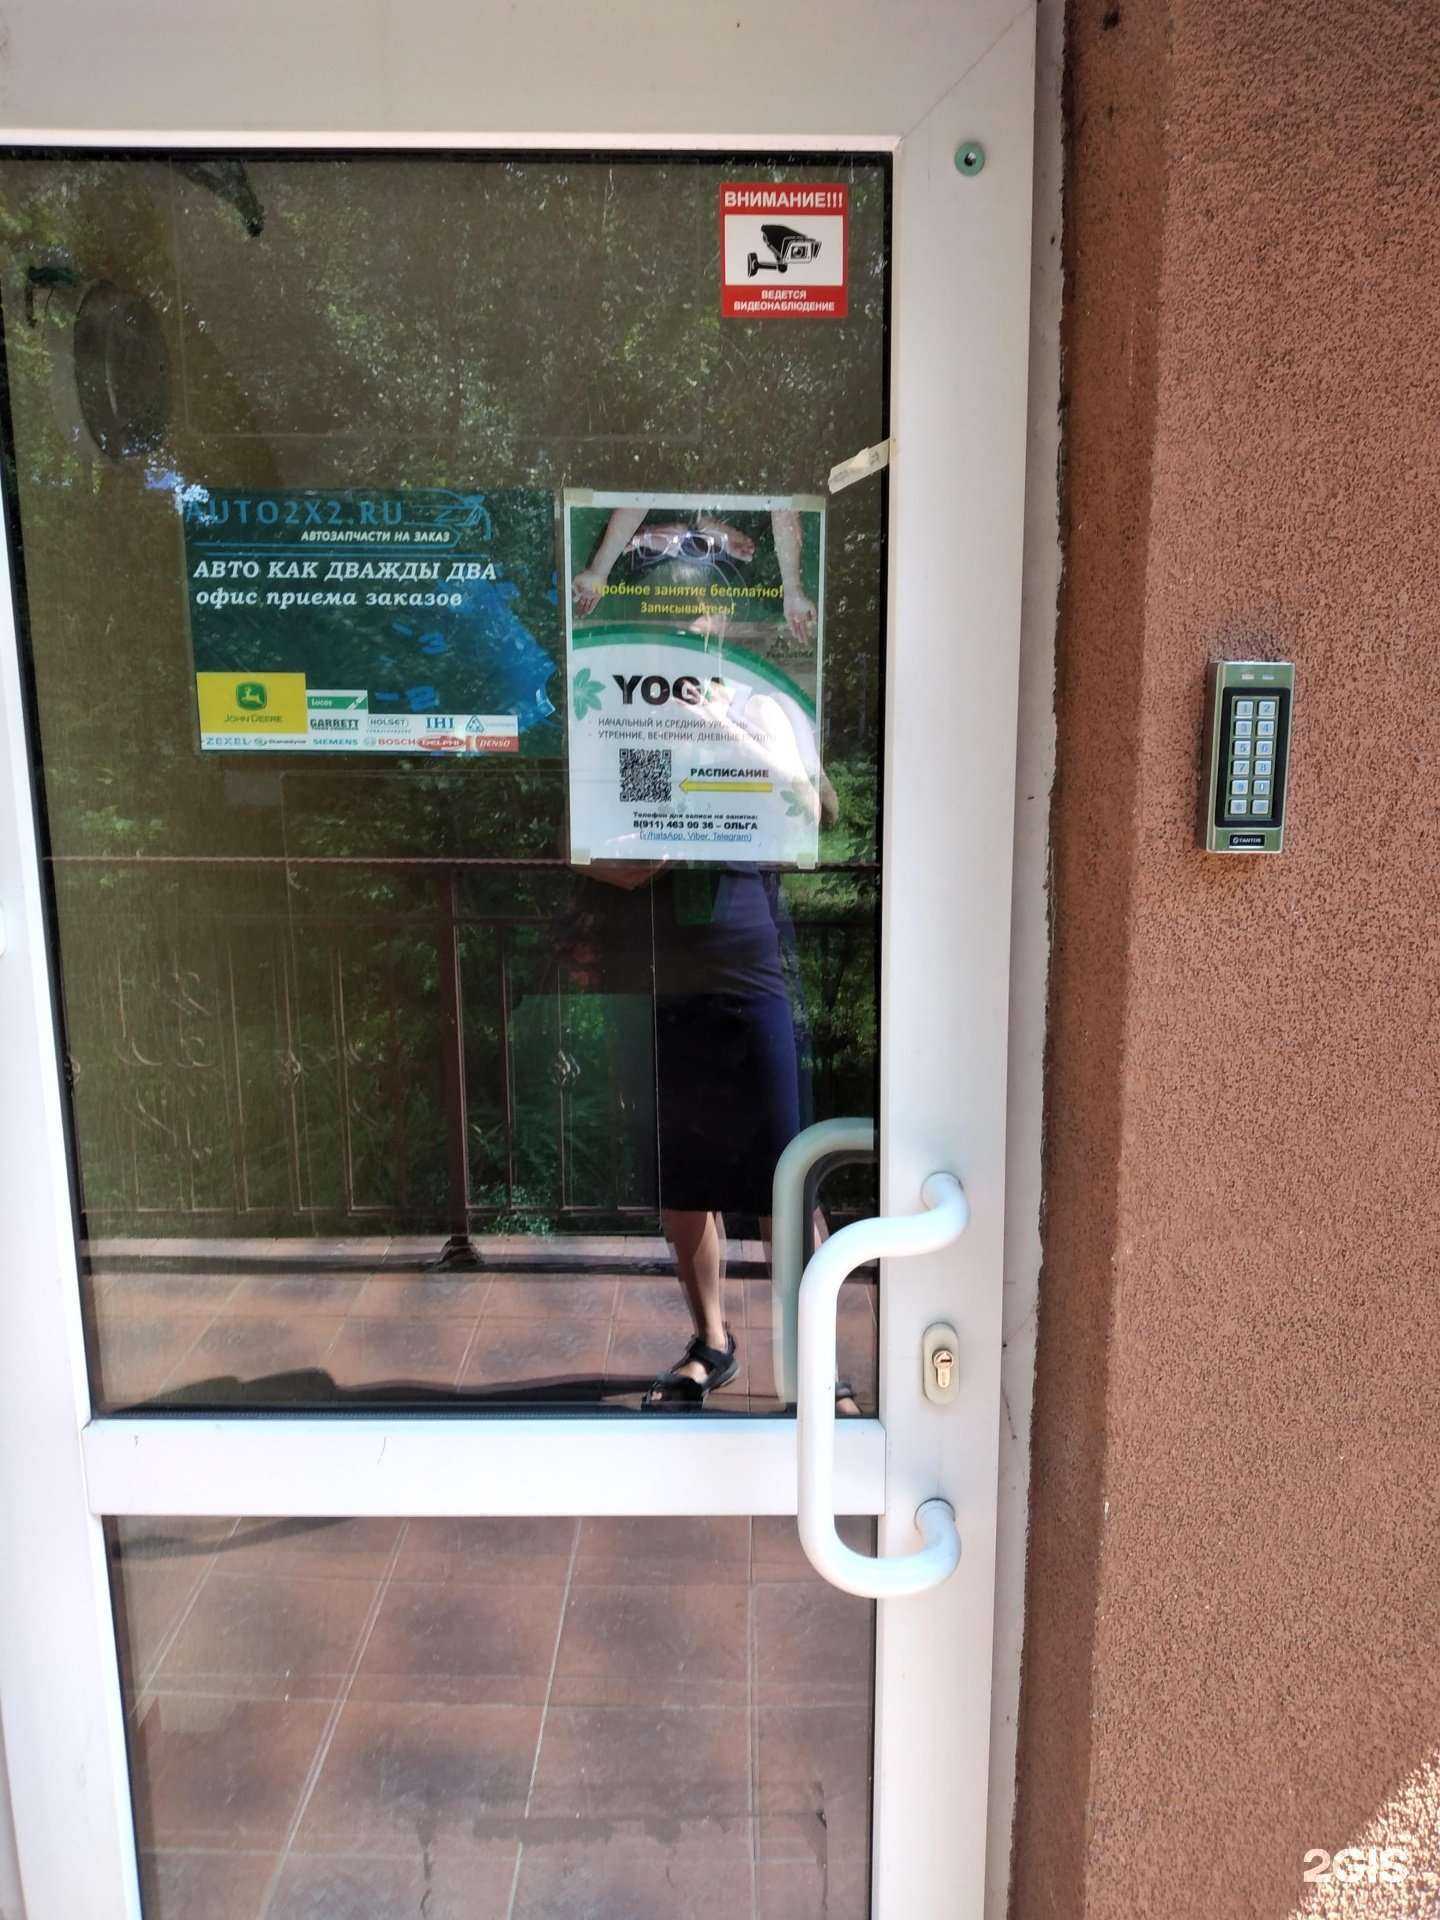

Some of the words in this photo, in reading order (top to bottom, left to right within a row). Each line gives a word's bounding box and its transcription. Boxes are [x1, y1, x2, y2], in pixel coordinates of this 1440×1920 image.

[725, 191, 843, 208] ВНИМАНИЕ!!!
[761, 289, 807, 300] ВЕДЕТСЯ
[734, 301, 835, 312] ВИДЕОНАБЛЮДЕНИЕ
[301, 530, 391, 542] АВТОЗАПЧАСТИ
[394, 531, 411, 542] НА
[414, 531, 451, 542] ЗАКАЗ
[193, 560, 260, 579] АВТО
[267, 561, 319, 579] КАК
[323, 561, 441, 582] ДВАЖДЫ
[445, 562, 498, 582] ДВА
[655, 585, 707, 597] занятие
[710, 583, 785, 598] бесплатно!
[196, 587, 258, 609] офис
[266, 590, 358, 610] приема
[365, 591, 464, 606] заказов
[613, 675, 728, 705] YOG
[426, 717, 455, 729] IHI
[598, 717, 653, 727] НАЧАЛЬНЫЙ
[656, 719, 662, 727] И
[690, 768, 769, 778] РАСПИСАНИЕ
[633, 820, 664, 830] 8(911)
[667, 821, 685, 829] 463
[687, 821, 699, 829] 00
[702, 821, 714, 830] 36
[723, 822, 758, 830] ОЛЬГА
[713, 832, 752, 842] Telegram)
